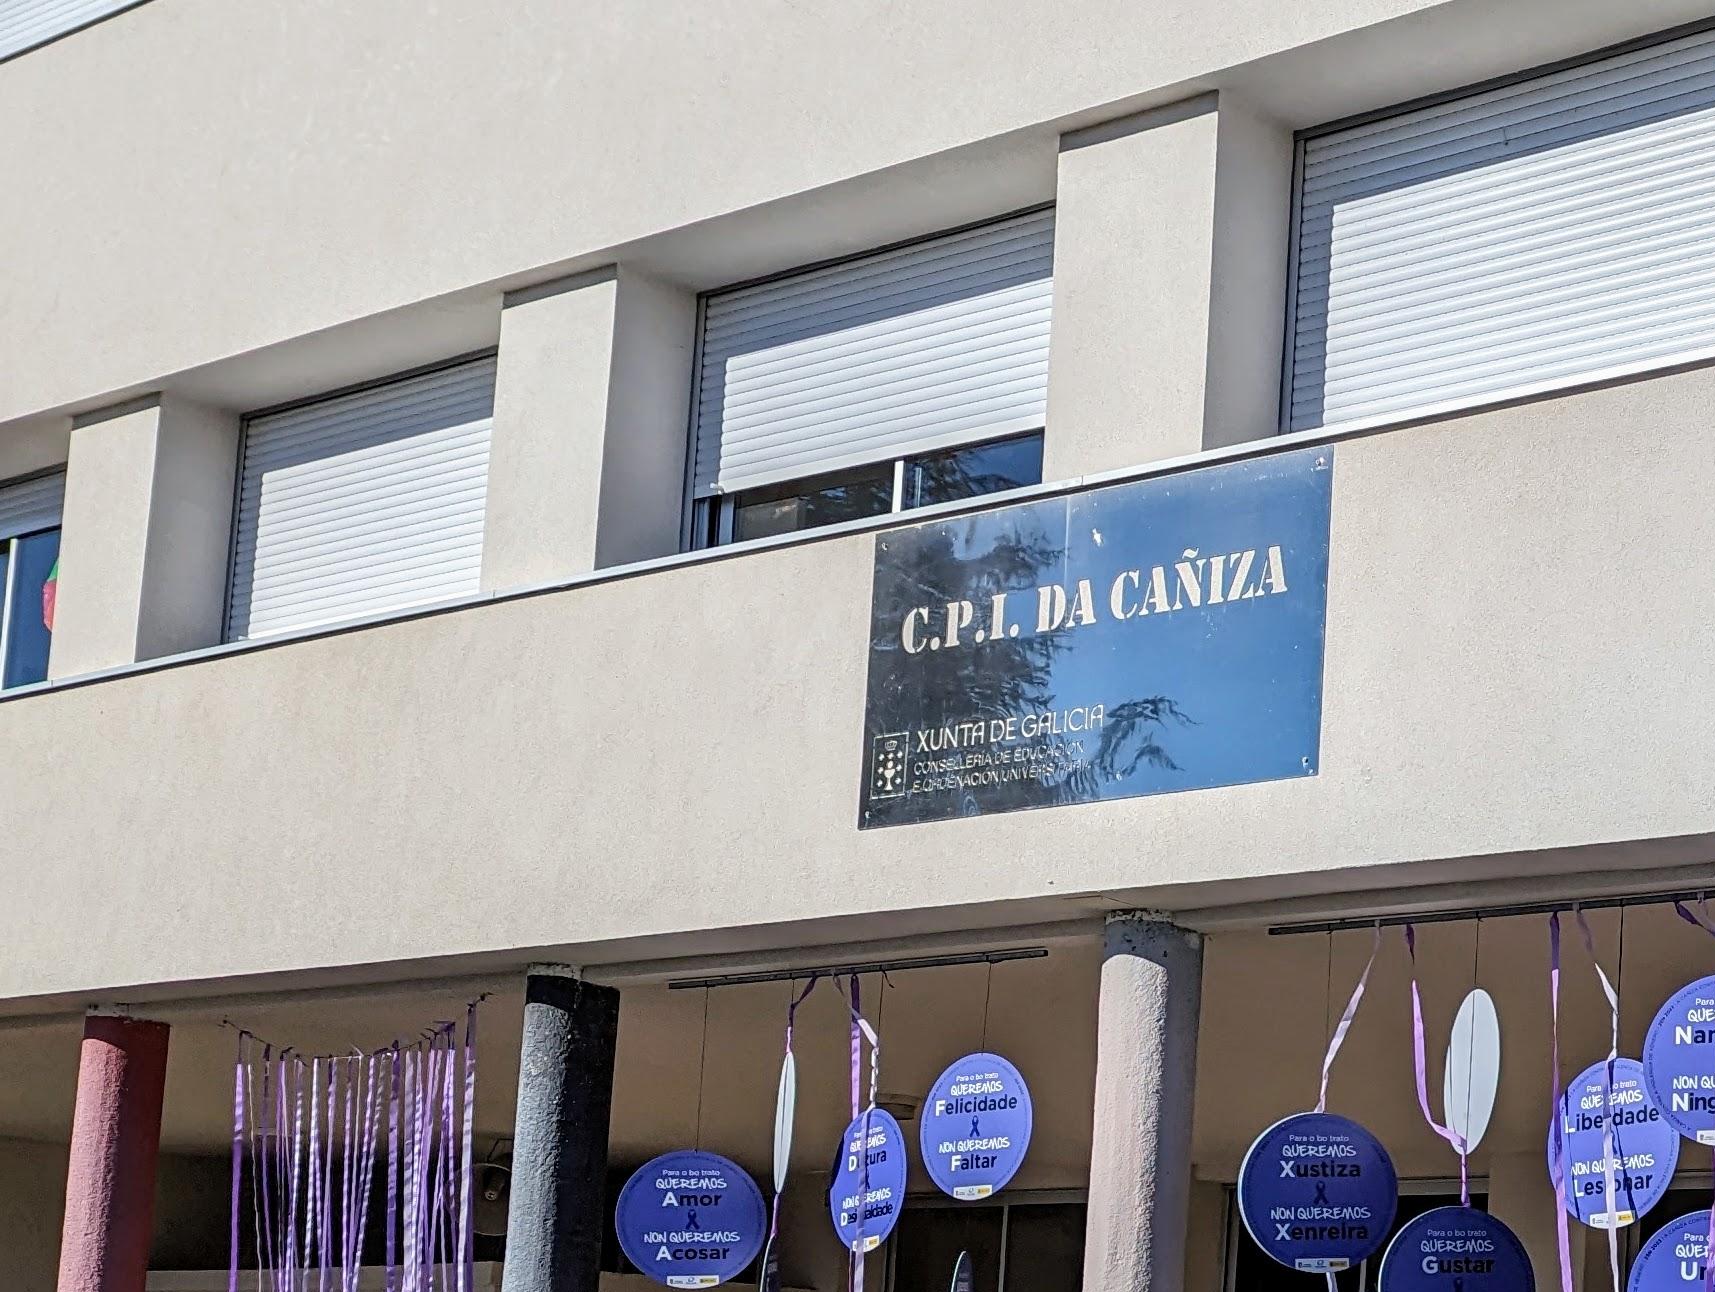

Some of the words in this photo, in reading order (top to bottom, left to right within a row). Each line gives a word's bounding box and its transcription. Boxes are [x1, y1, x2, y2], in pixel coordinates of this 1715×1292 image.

[902, 593, 1019, 654] C.P.I.
[1035, 579, 1097, 633] DA
[1110, 545, 1288, 620] CAÑIZA
[917, 721, 985, 752] XUNTA
[990, 718, 1017, 742] DE
[1021, 704, 1104, 737] GALICIA
[1696, 998, 1714, 1006] Para
[950, 1080, 1004, 1096] QUEREMOS
[1620, 1080, 1637, 1088] trato
[1672, 1075, 1698, 1090] NON
[936, 1094, 1018, 1116] Felicidade
[1580, 1090, 1644, 1110] QUEEMOS
[1564, 1104, 1660, 1134] Libedade
[850, 1133, 886, 1152] QUEEMOS
[938, 1141, 956, 1154] NON
[958, 1136, 1011, 1152] QUEREMOS
[1316, 1134, 1328, 1142] bo
[1282, 1144, 1357, 1158] QUEREMOS
[848, 1150, 887, 1172] Dura
[950, 1154, 998, 1172] Faltar
[1279, 1160, 1361, 1178] Xustiza
[1570, 1160, 1590, 1176] NON
[1592, 1154, 1655, 1174] QUREMOS
[655, 1178, 728, 1190] QUEREMOS
[1574, 1174, 1654, 1198] Lesonar
[662, 1192, 722, 1207] Amor
[854, 1188, 892, 1206] QREMOS
[840, 1201, 893, 1226] Desialdade
[1270, 1207, 1294, 1220] NON
[1297, 1206, 1372, 1220] QUEREMOS
[644, 1232, 667, 1244] NON
[669, 1230, 741, 1243] QUEREMOS
[1275, 1222, 1368, 1241] Xenreira
[1684, 1233, 1704, 1242] Para
[656, 1246, 730, 1261] Acosar
[1420, 1238, 1494, 1253] QUEREMOS
[1422, 1256, 1496, 1274] Gustar
